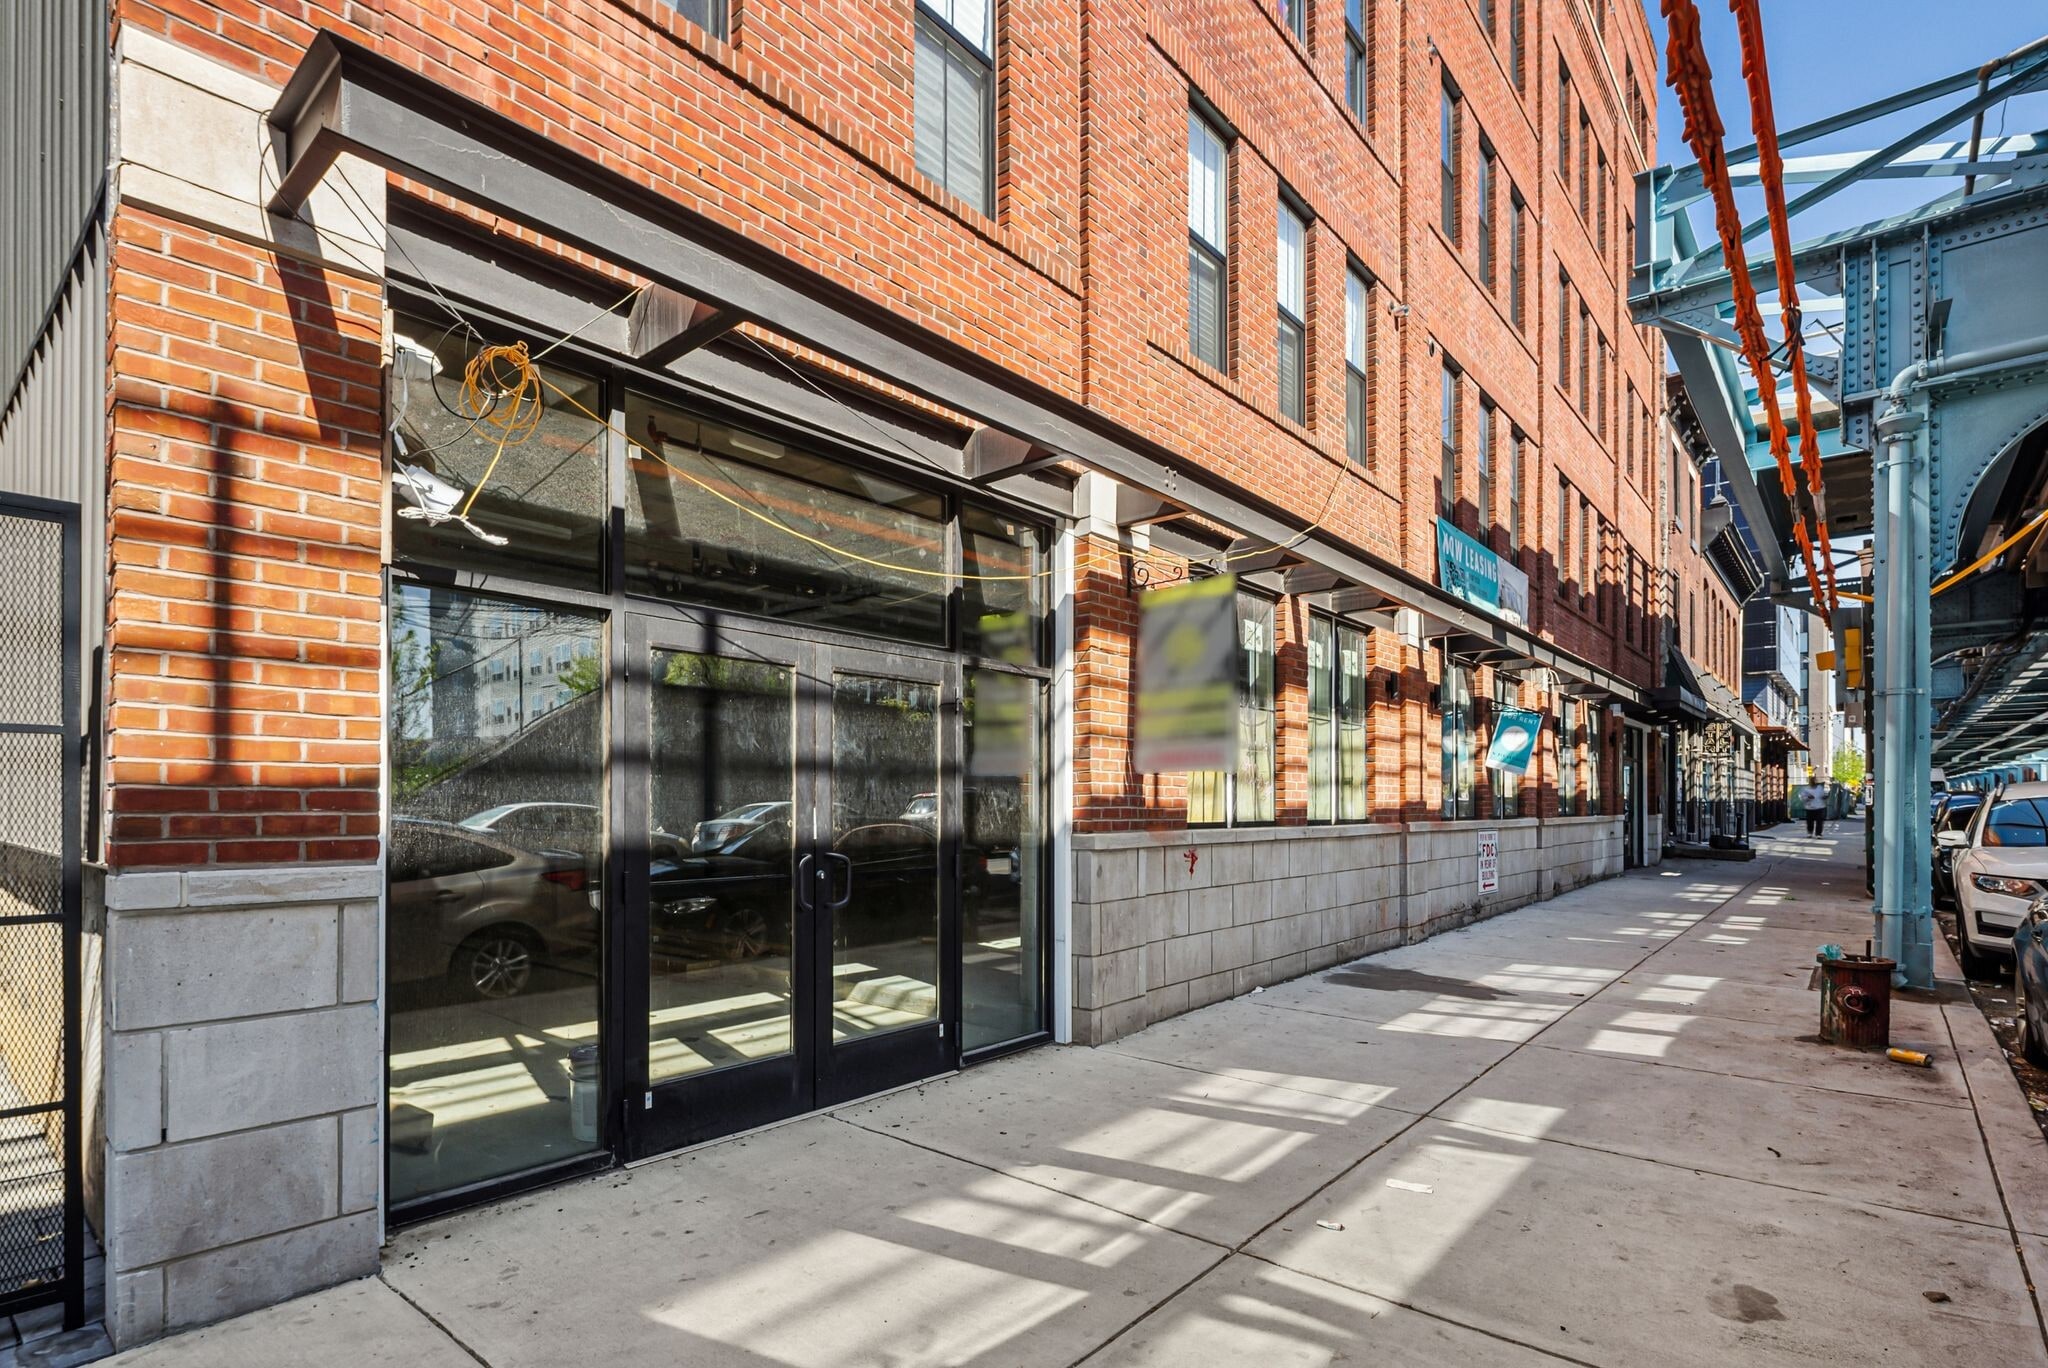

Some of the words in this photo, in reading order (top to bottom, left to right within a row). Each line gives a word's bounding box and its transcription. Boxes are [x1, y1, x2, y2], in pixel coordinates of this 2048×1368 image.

[1442, 531, 1463, 562] NOW
[1465, 546, 1497, 583] LEASING
[1519, 716, 1538, 726] RENT
[1482, 843, 1495, 858] FDC
